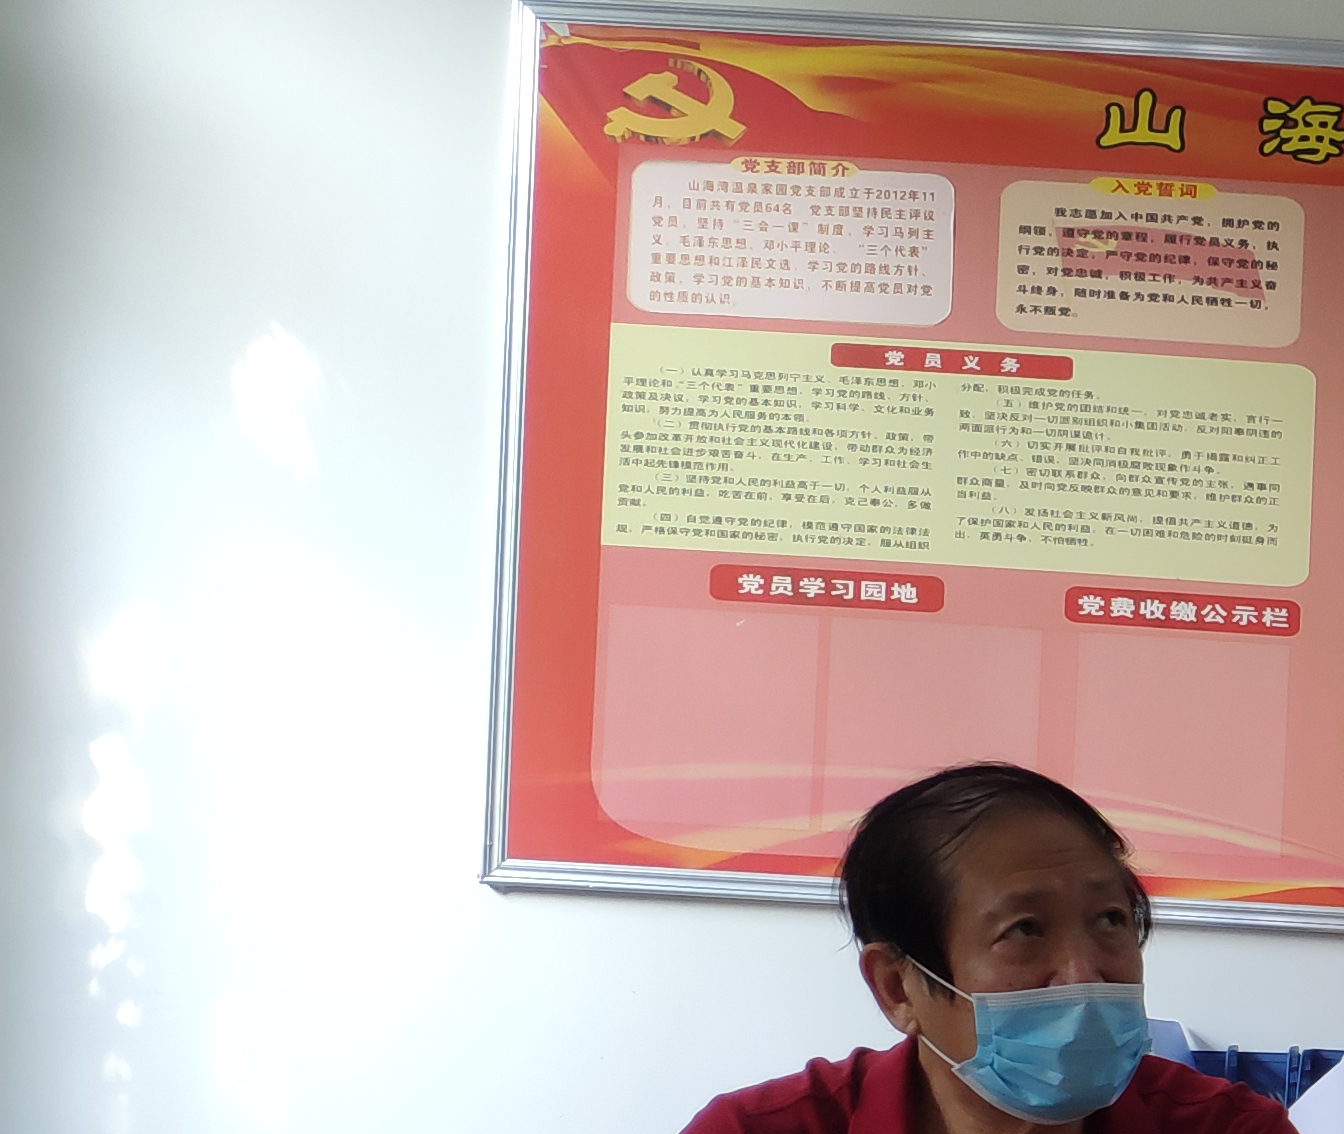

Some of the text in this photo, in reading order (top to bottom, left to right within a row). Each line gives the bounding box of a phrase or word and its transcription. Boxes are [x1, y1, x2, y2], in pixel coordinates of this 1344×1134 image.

[740, 158, 850, 179] 党支部简介
[1111, 179, 1198, 198] 入党誓词
[884, 350, 1021, 374] 党员义务
[737, 573, 919, 603] 党员学习园地
[1077, 594, 1290, 629] 党费收缴公示栏
